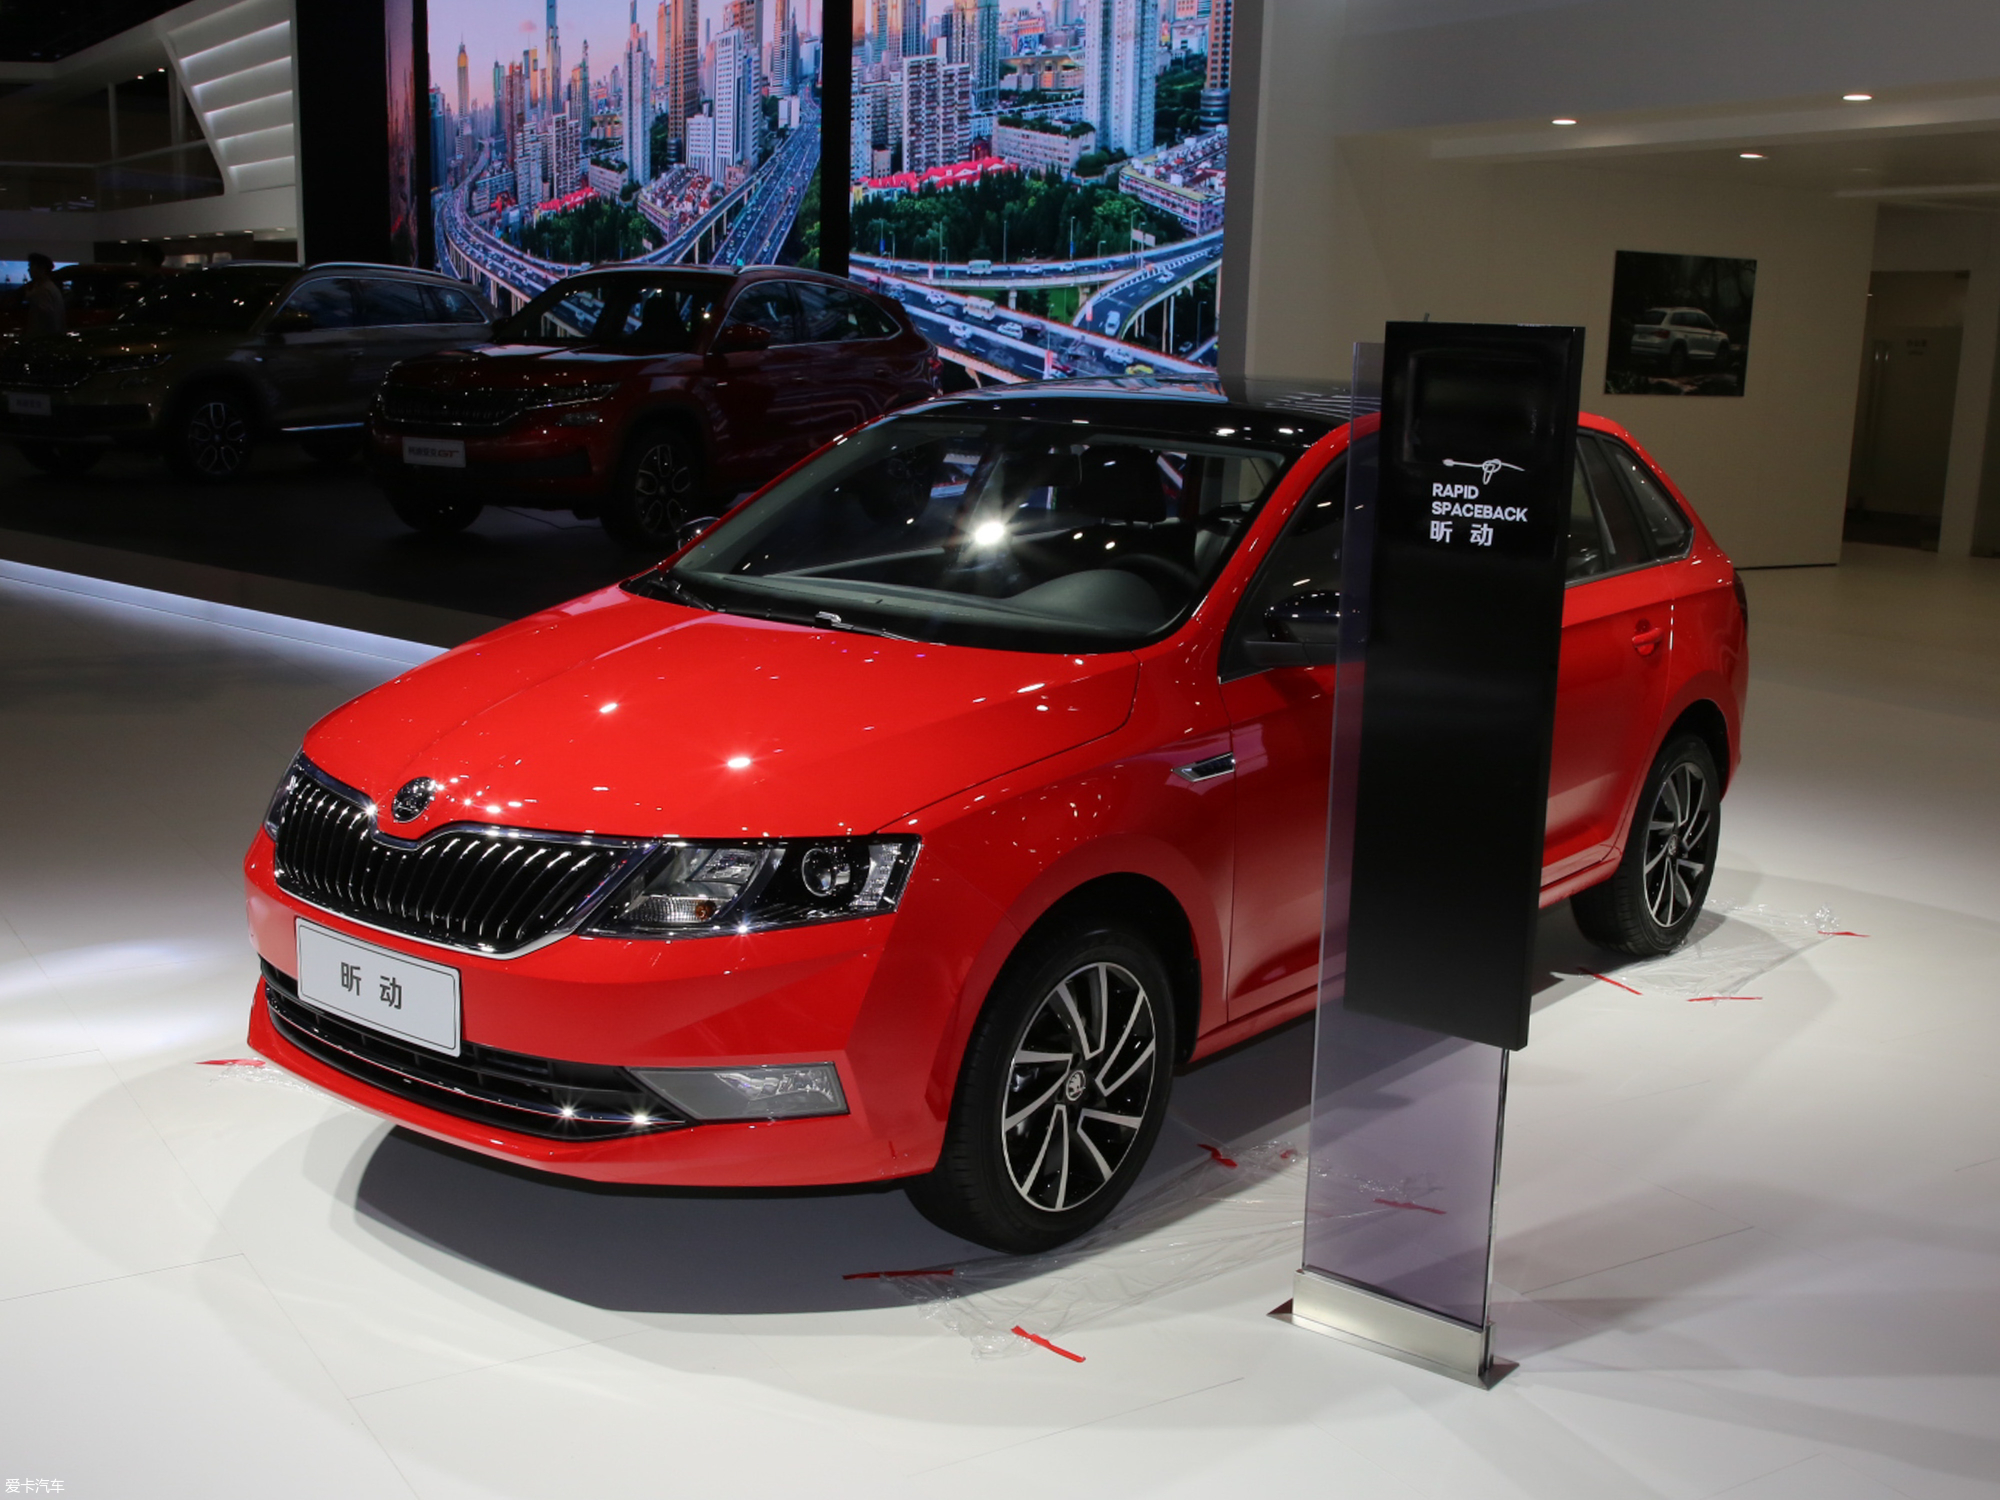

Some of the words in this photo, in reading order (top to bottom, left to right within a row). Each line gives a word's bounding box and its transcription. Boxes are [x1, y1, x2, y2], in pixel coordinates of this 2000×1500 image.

[1432, 482, 1479, 499] RAPID
[1431, 501, 1528, 522] SPACEBACK
[1430, 520, 1493, 546] 昕动
[340, 961, 402, 1010] 昕动
